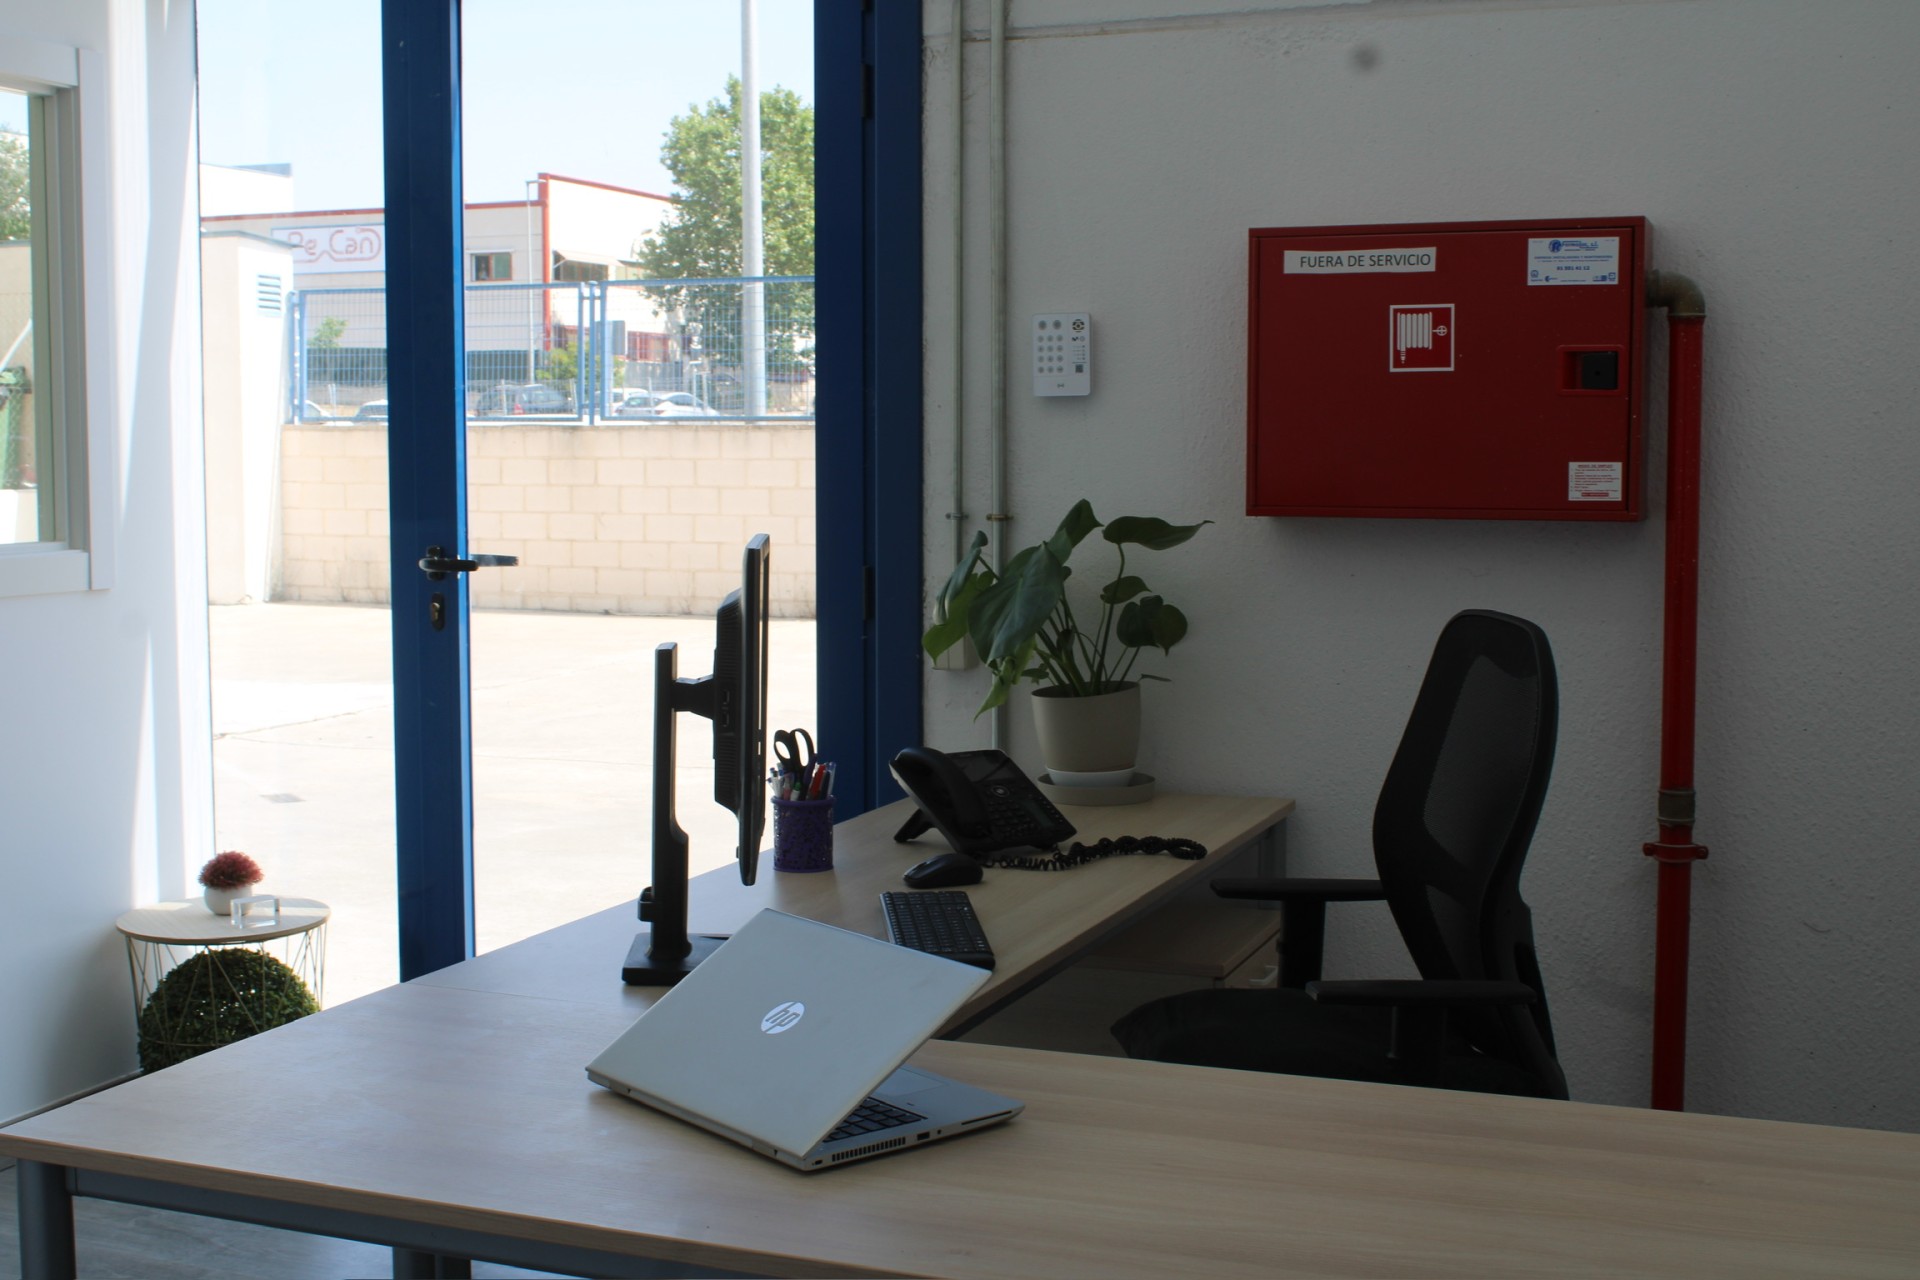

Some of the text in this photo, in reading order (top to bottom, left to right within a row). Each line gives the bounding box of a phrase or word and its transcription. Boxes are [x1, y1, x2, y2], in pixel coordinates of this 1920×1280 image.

[1300, 253, 1431, 268] FUERA DE SERVICIO
[762, 1001, 804, 1034] hp
